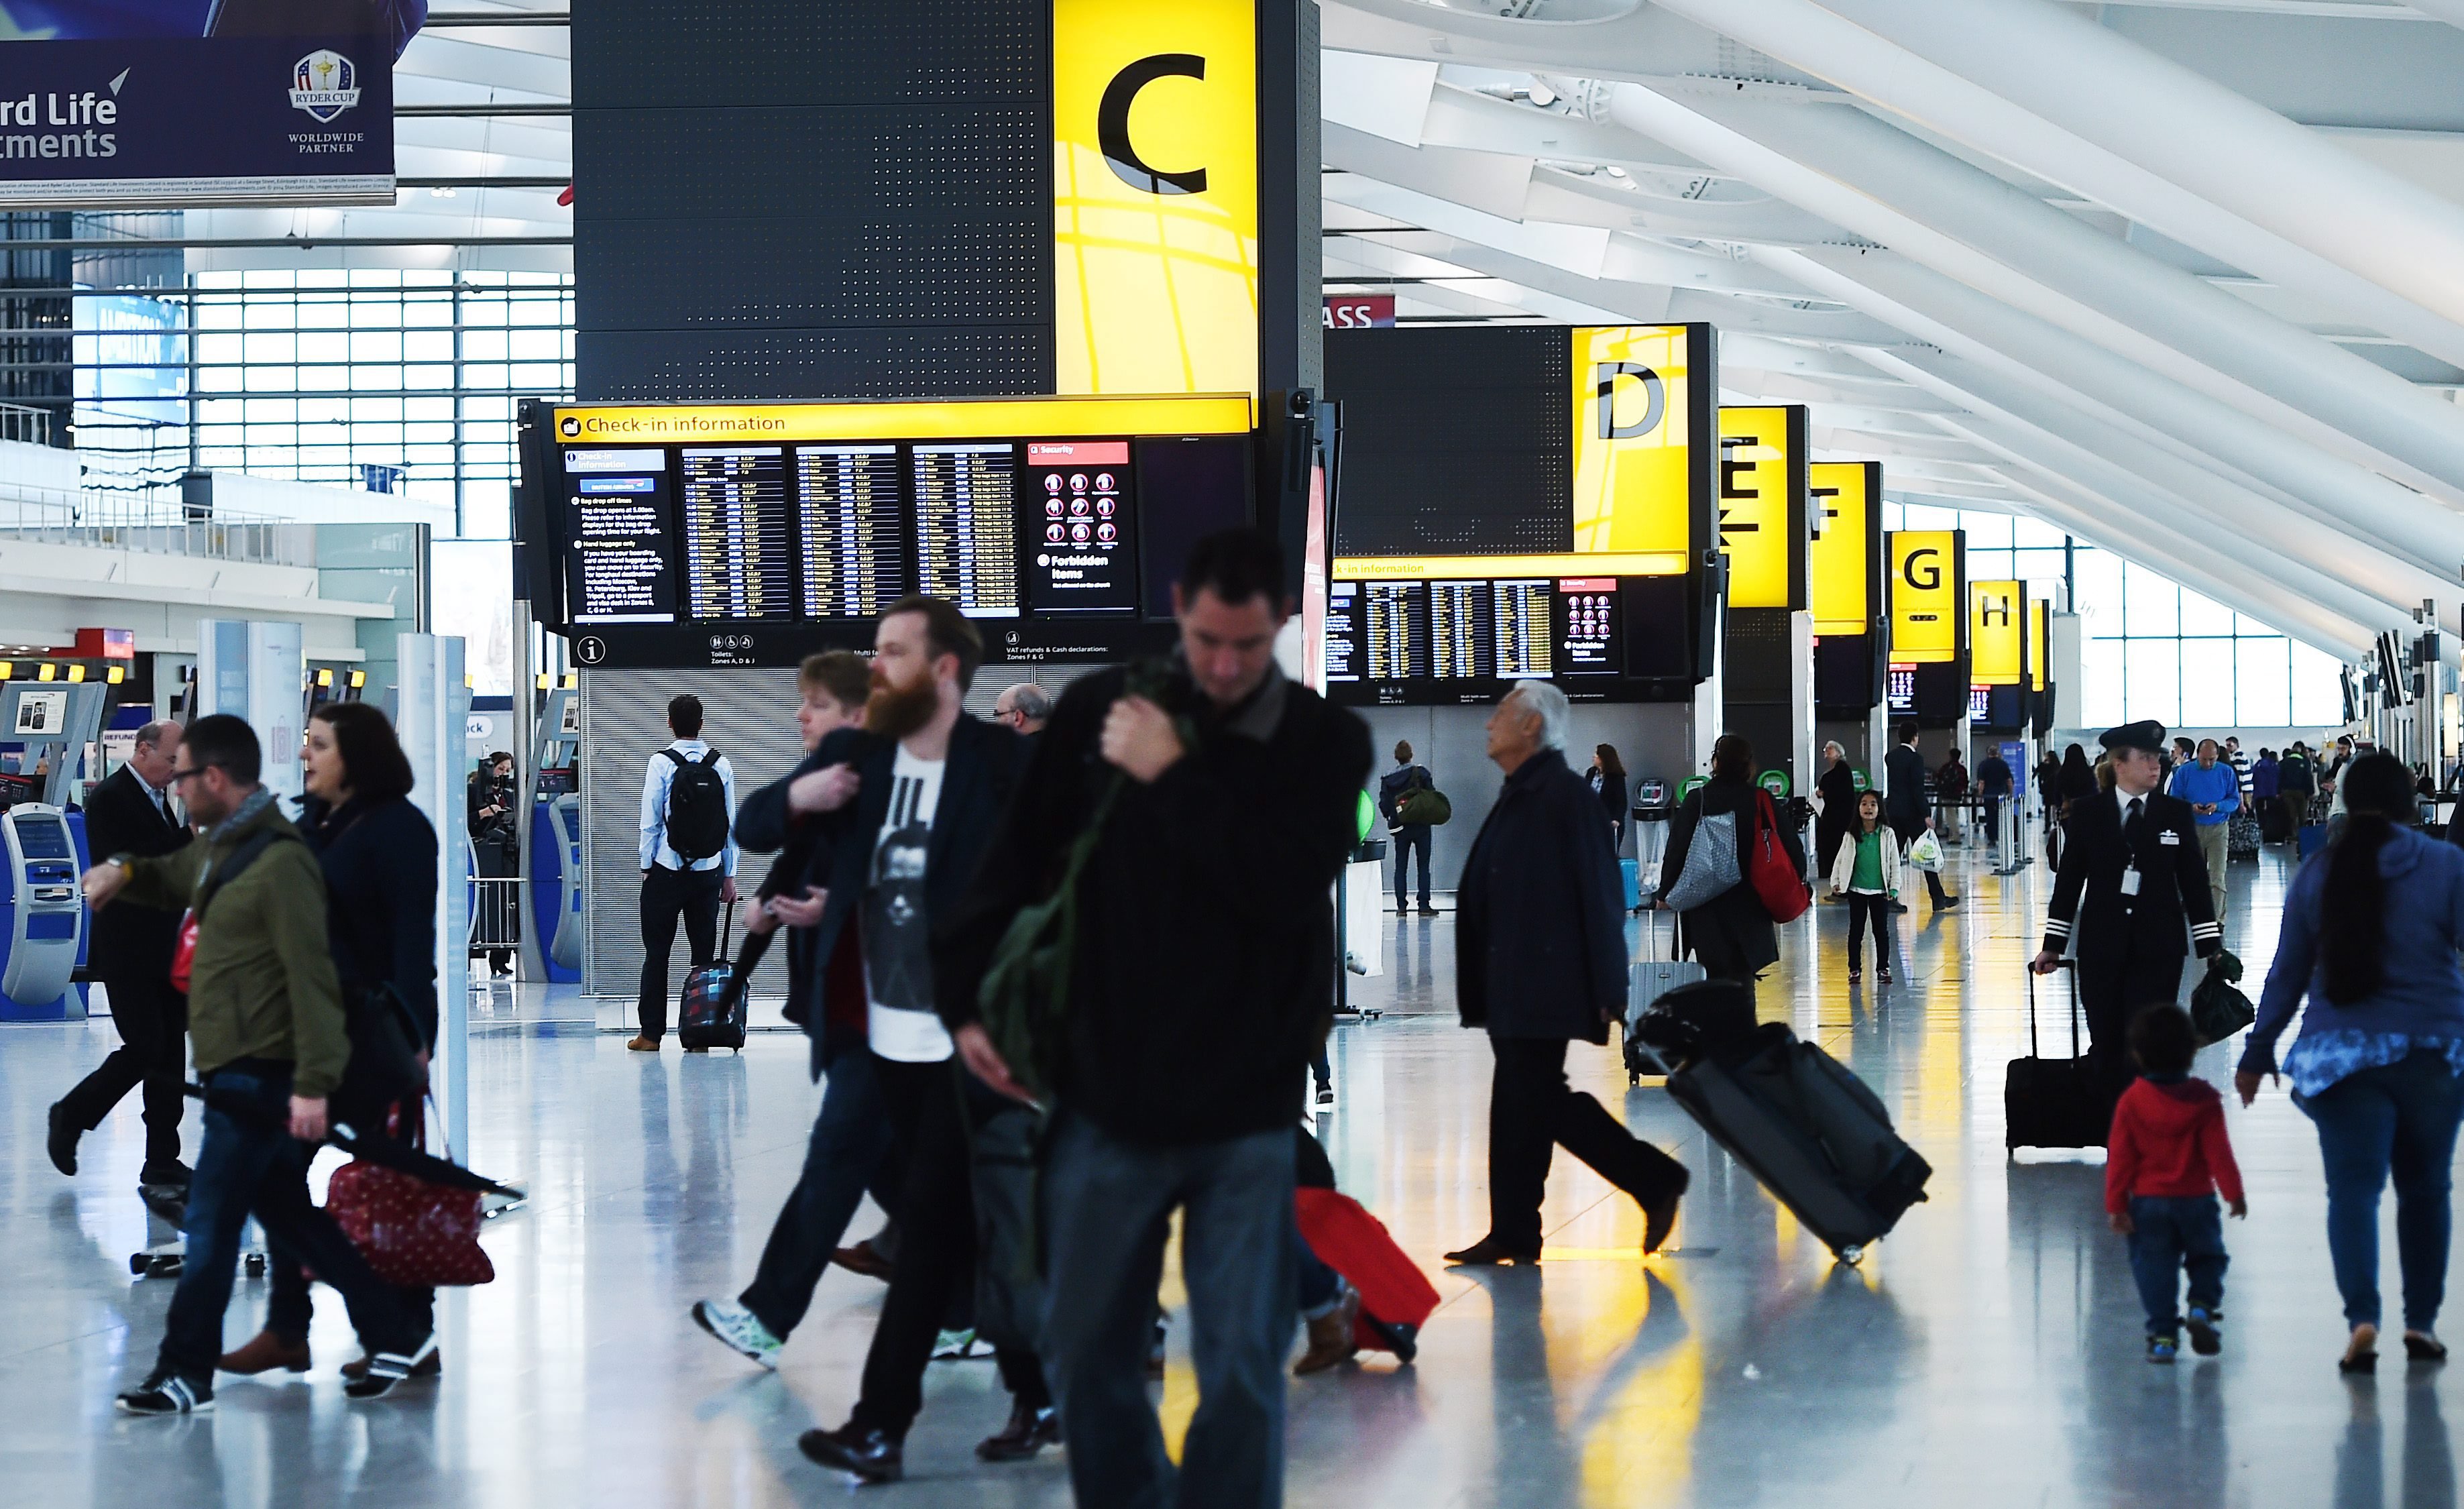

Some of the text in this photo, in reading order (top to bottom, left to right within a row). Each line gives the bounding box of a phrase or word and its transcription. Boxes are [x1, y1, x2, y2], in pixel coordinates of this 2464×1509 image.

[0, 92, 117, 126] rd Life
[295, 93, 355, 103] RYDER CUP
[1098, 53, 1207, 194] C
[288, 133, 364, 143] WORLDWIDE
[299, 144, 353, 153] PARTNER
[1598, 362, 1665, 439] D
[586, 416, 785, 433] Check-in information
[1041, 445, 1073, 455] Security
[1721, 437, 1758, 498] E
[1811, 488, 1839, 541] F
[1051, 555, 1109, 566] Forbidden
[1334, 564, 1424, 573] k-in information
[1904, 549, 1940, 590] G
[1982, 596, 2008, 626] H
